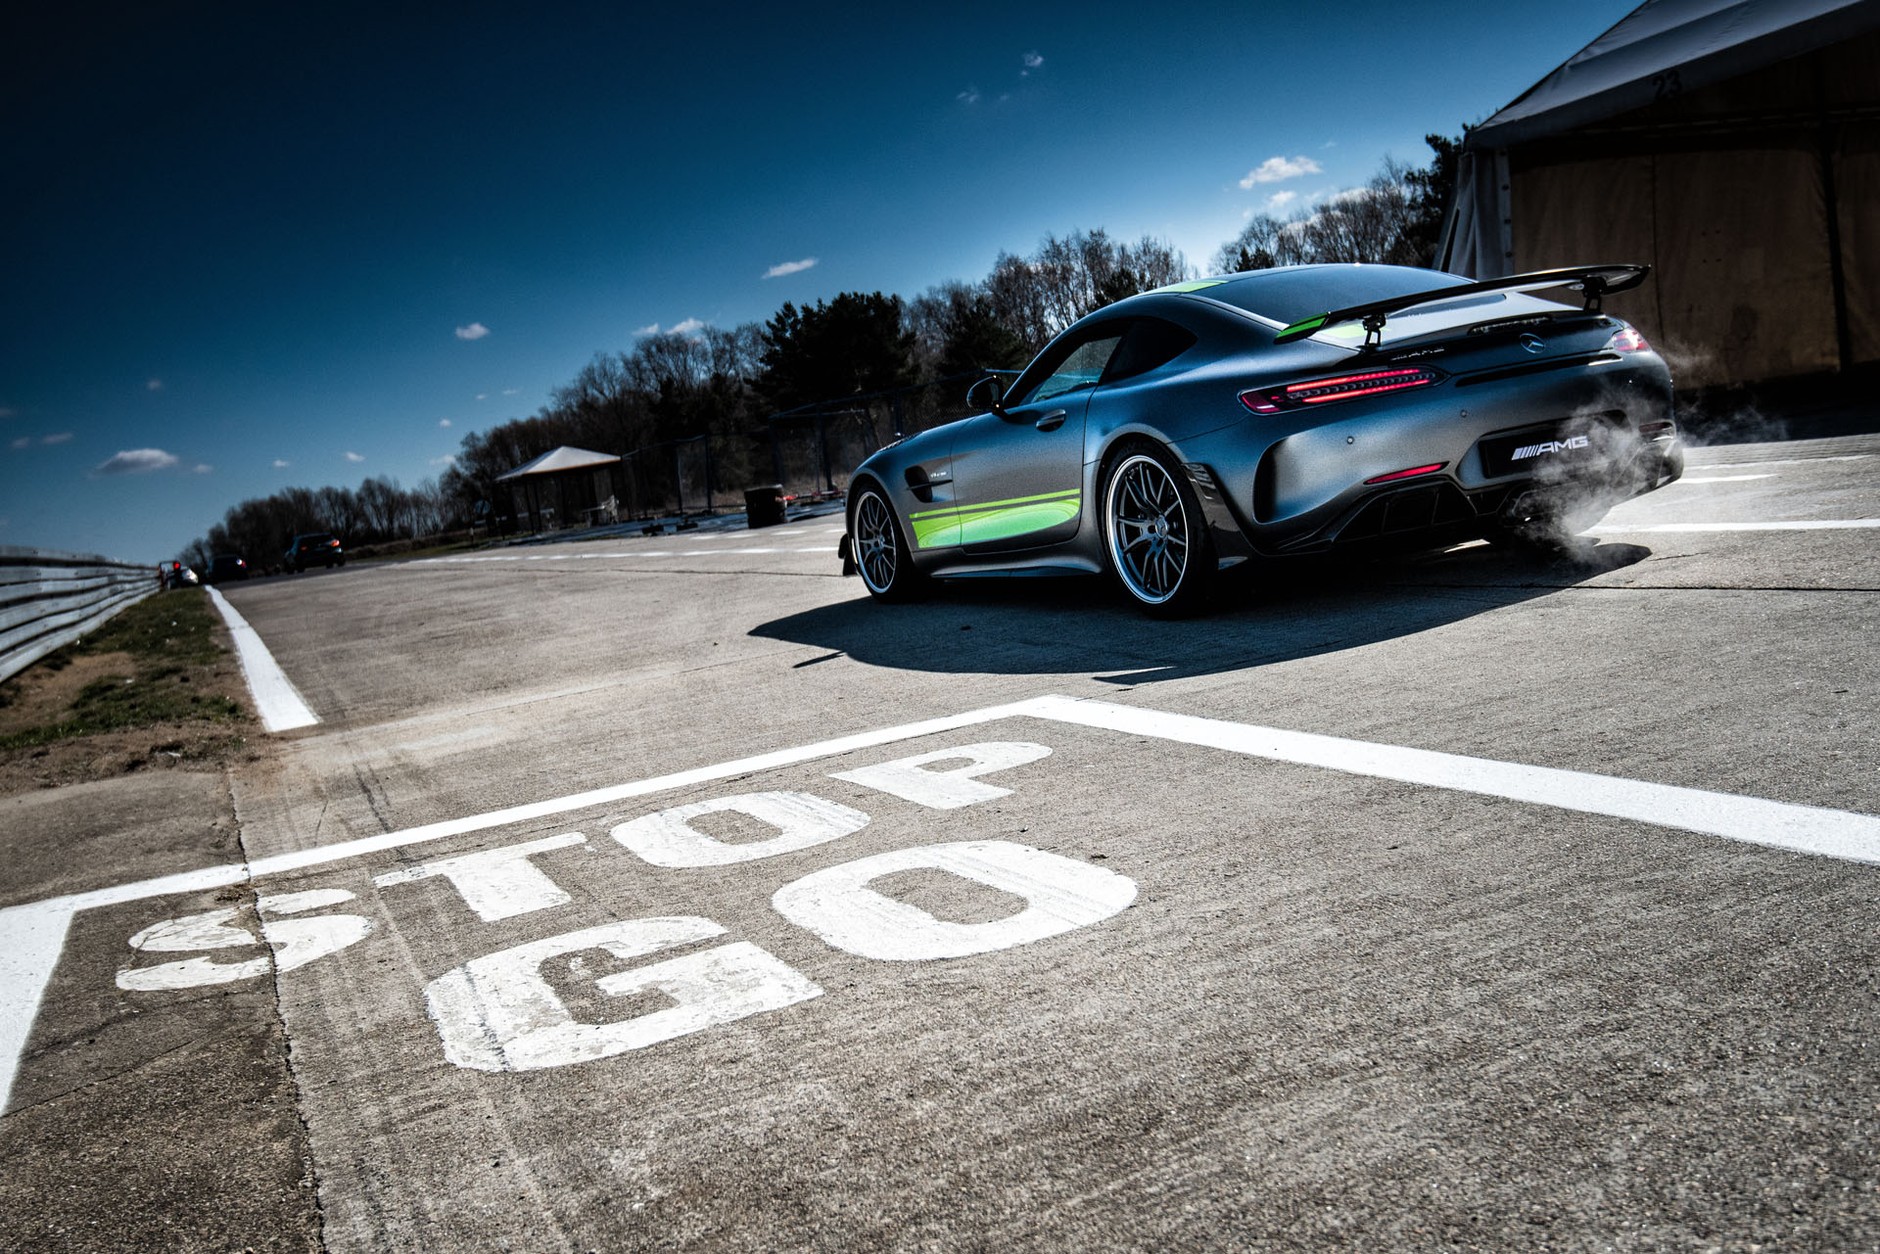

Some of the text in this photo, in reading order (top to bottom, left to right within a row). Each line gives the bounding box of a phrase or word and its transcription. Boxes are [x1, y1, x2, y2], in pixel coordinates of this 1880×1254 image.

[1652, 70, 1681, 101] 23
[1534, 435, 1589, 457] AMG
[116, 741, 1053, 992] STOP
[425, 840, 1138, 1073] GO
